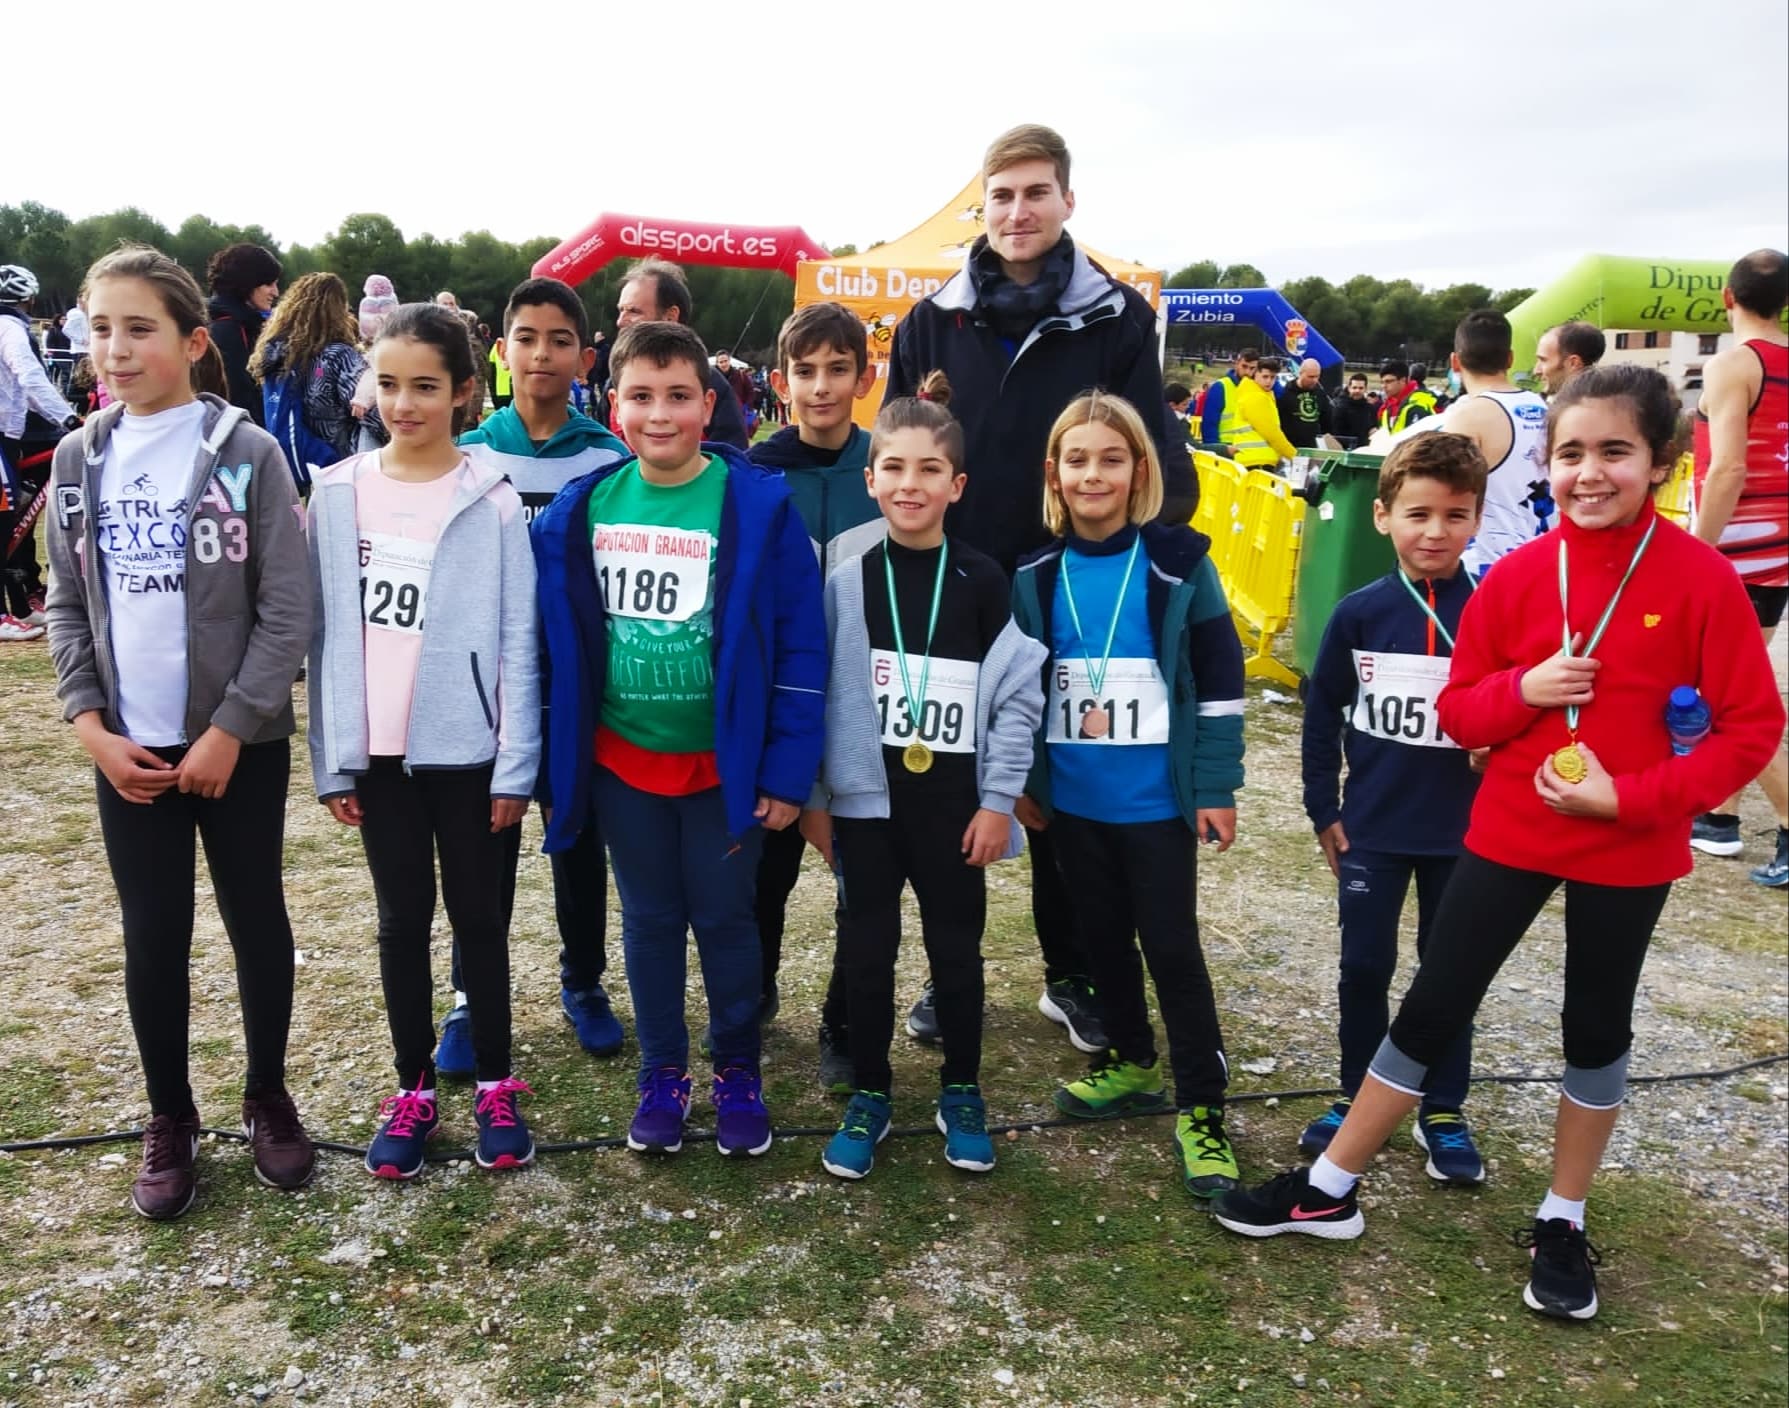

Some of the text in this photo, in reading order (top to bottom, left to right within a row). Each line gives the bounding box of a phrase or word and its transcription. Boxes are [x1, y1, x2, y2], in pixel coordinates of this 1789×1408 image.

[620, 221, 776, 256] alssport.es
[816, 265, 878, 296] Club
[1175, 310, 1235, 322] Zubia
[1640, 296, 1675, 321] de
[117, 499, 160, 518] TRI
[192, 517, 248, 564] 83
[656, 533, 708, 561] GRANADA
[116, 572, 185, 593] TEAM
[600, 565, 680, 615] 1186
[360, 576, 428, 631] 129
[877, 693, 964, 745] 1309
